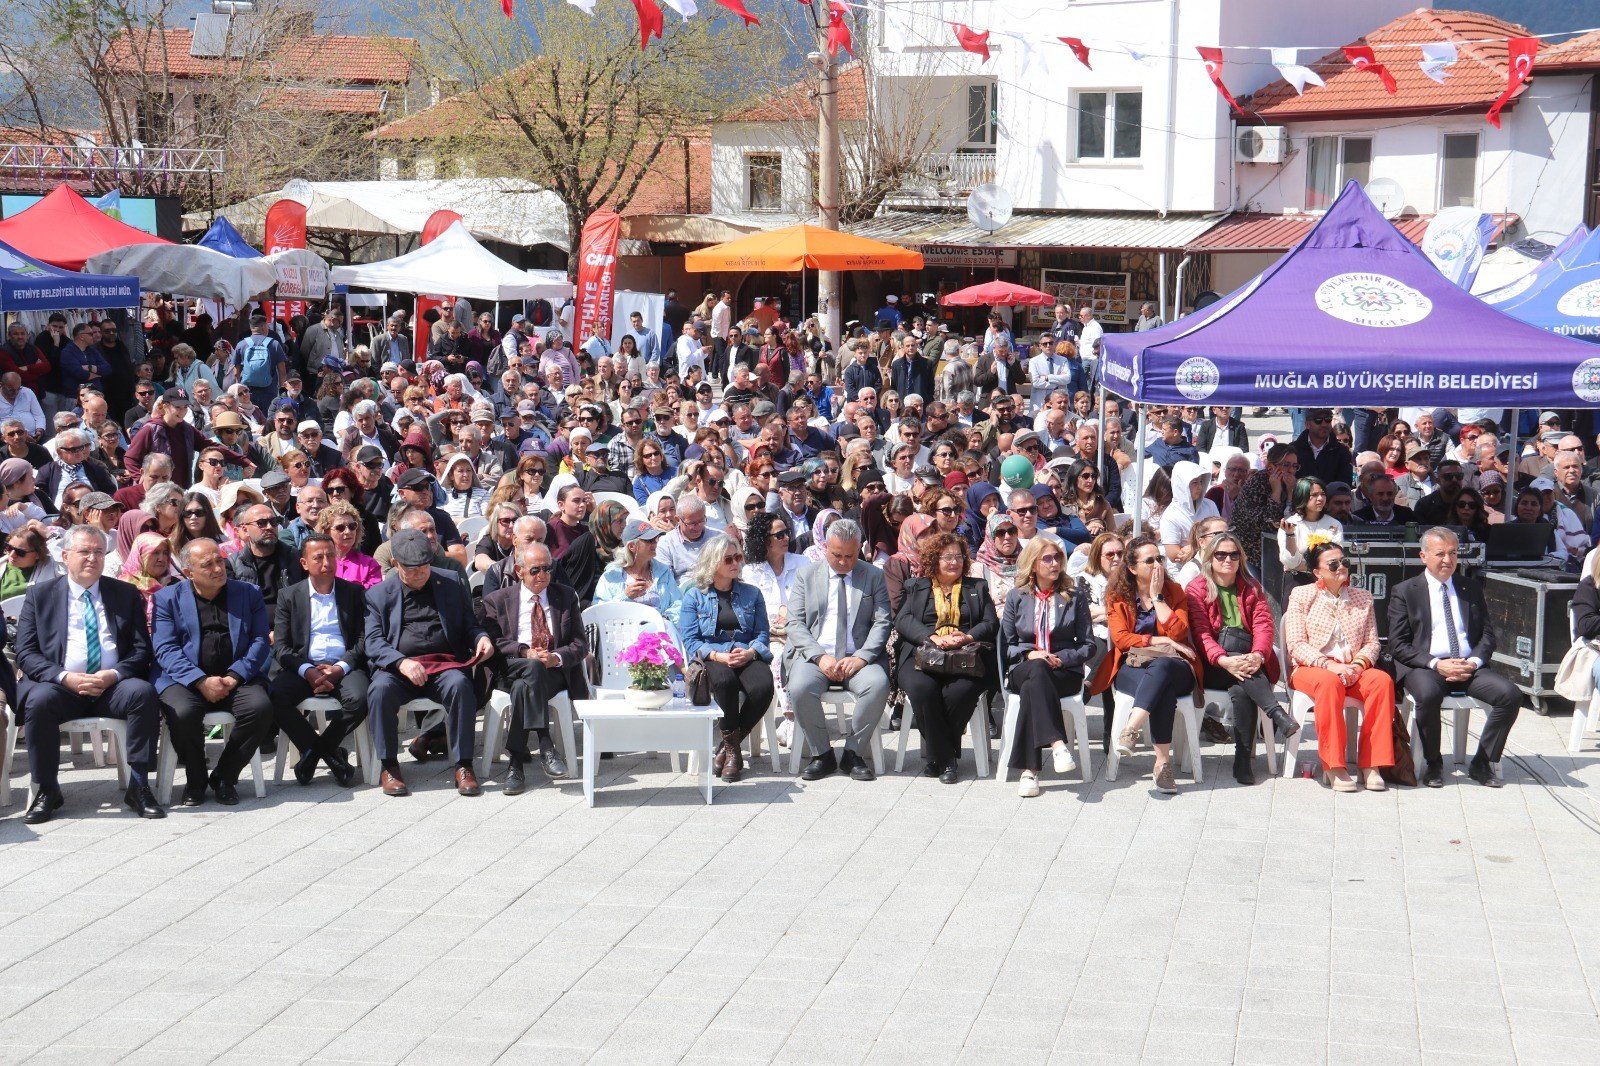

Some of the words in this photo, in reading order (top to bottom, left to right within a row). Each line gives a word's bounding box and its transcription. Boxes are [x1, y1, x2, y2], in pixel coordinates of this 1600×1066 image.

[585, 253, 615, 267] CHP
[13, 287, 40, 300] FETHİYE
[41, 285, 75, 300] BELEDİYESİ
[75, 285, 99, 297] KÜLTÜR
[1254, 372, 1319, 389] MUĞLA
[1323, 371, 1435, 393] BÜYÜKŞEHİR
[1439, 371, 1538, 390] BELEDİYESİ
